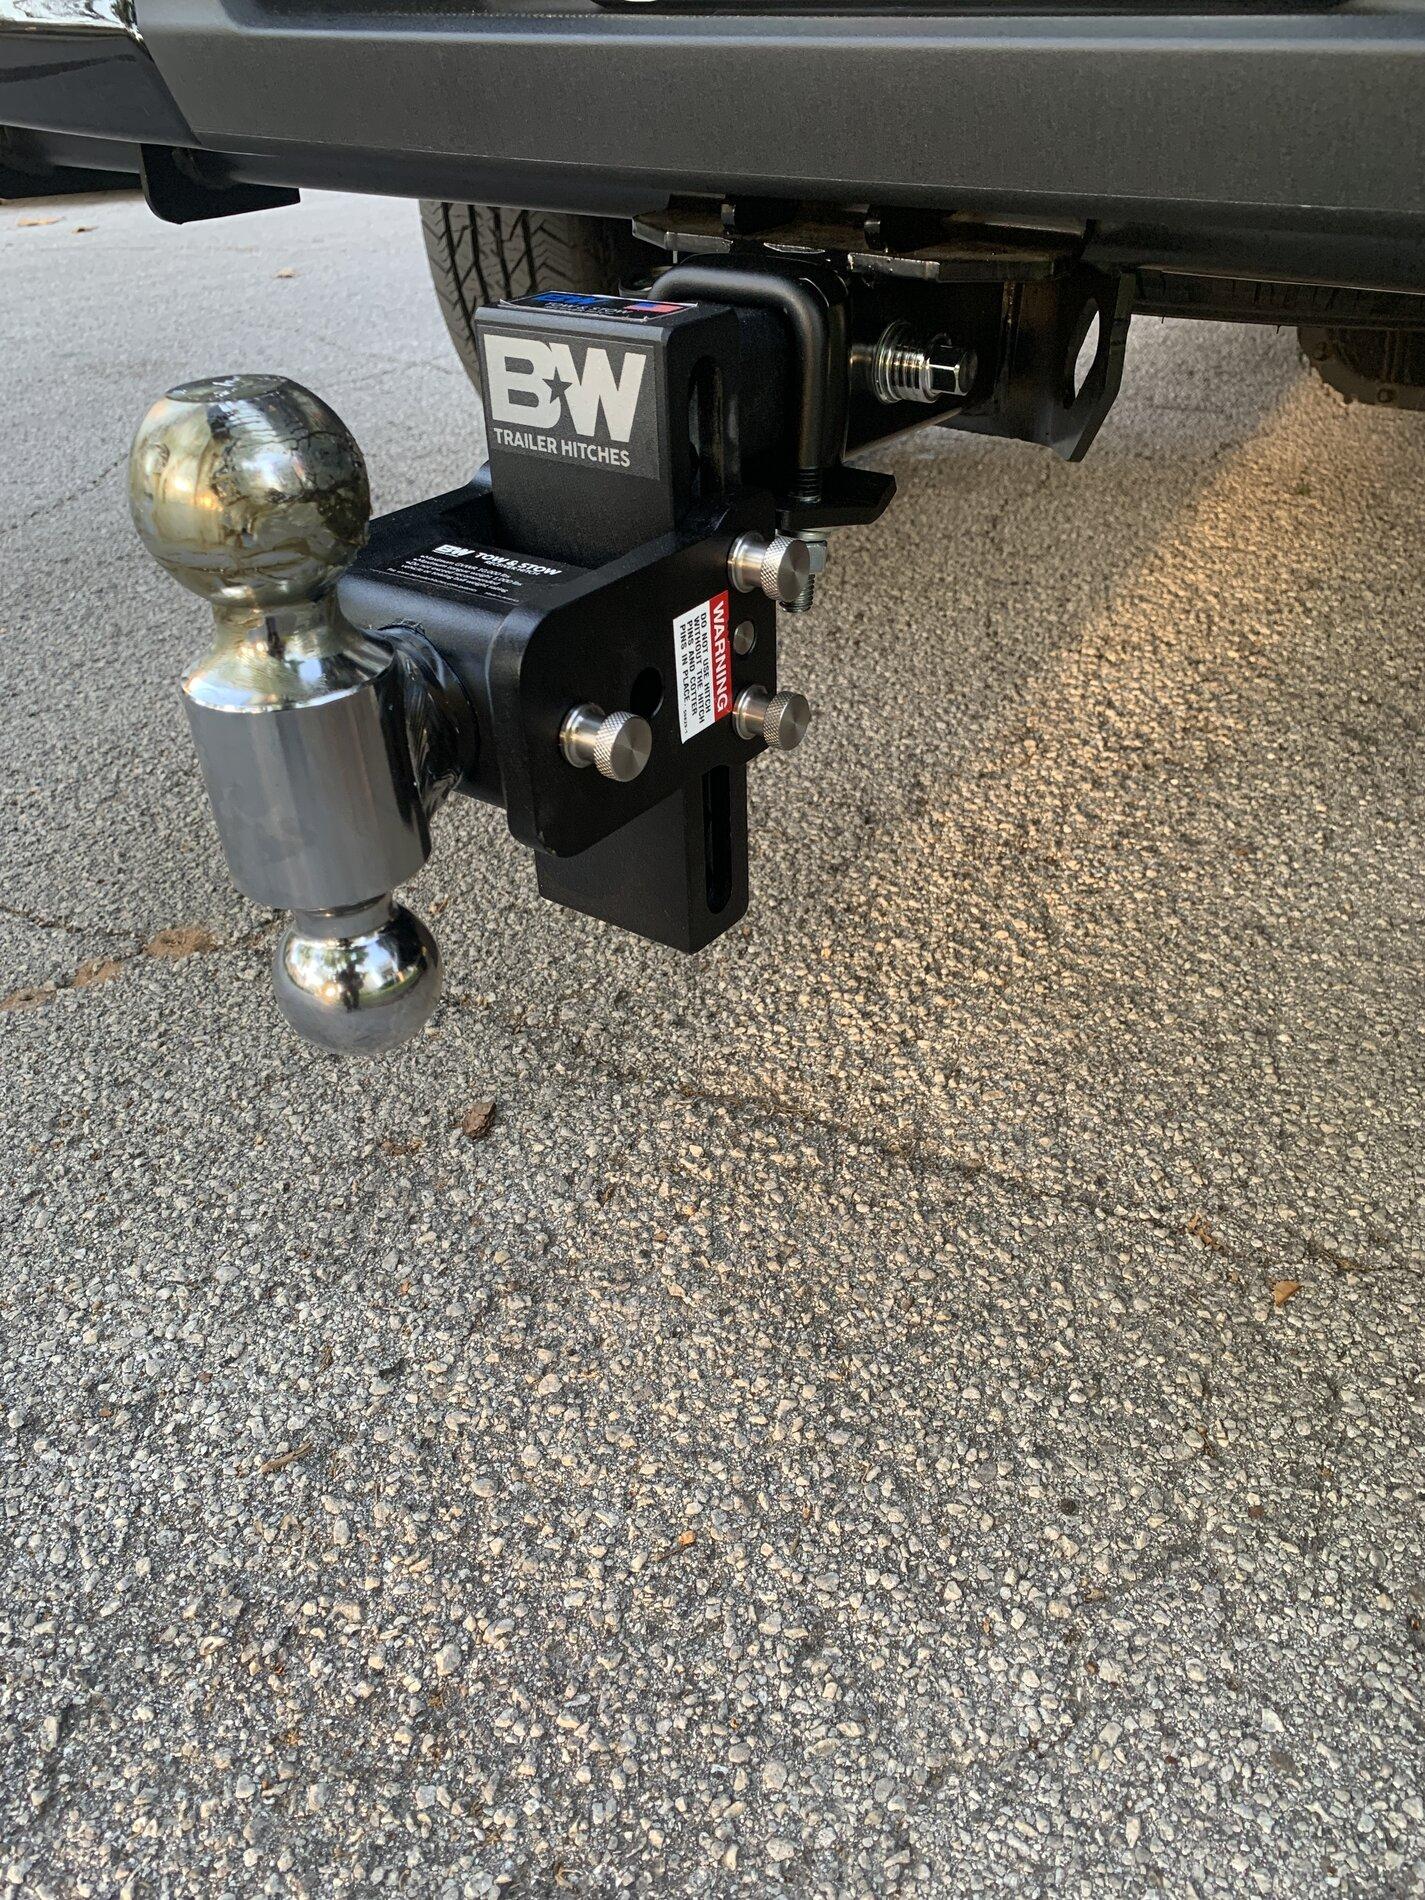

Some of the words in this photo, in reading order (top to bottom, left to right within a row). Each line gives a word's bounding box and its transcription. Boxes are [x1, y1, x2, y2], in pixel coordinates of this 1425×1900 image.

[494, 427, 557, 455] TRAILER
[561, 439, 631, 468] HITCHES
[475, 552, 510, 563] TOW
[518, 562, 562, 576] STOW
[687, 619, 695, 646] PINS
[701, 612, 708, 629] DO
[680, 623, 688, 650] PINS
[694, 615, 702, 665] WITHOUT
[682, 653, 688, 666] IN
[713, 600, 728, 712] WARNING
[690, 676, 698, 716] COTTER
